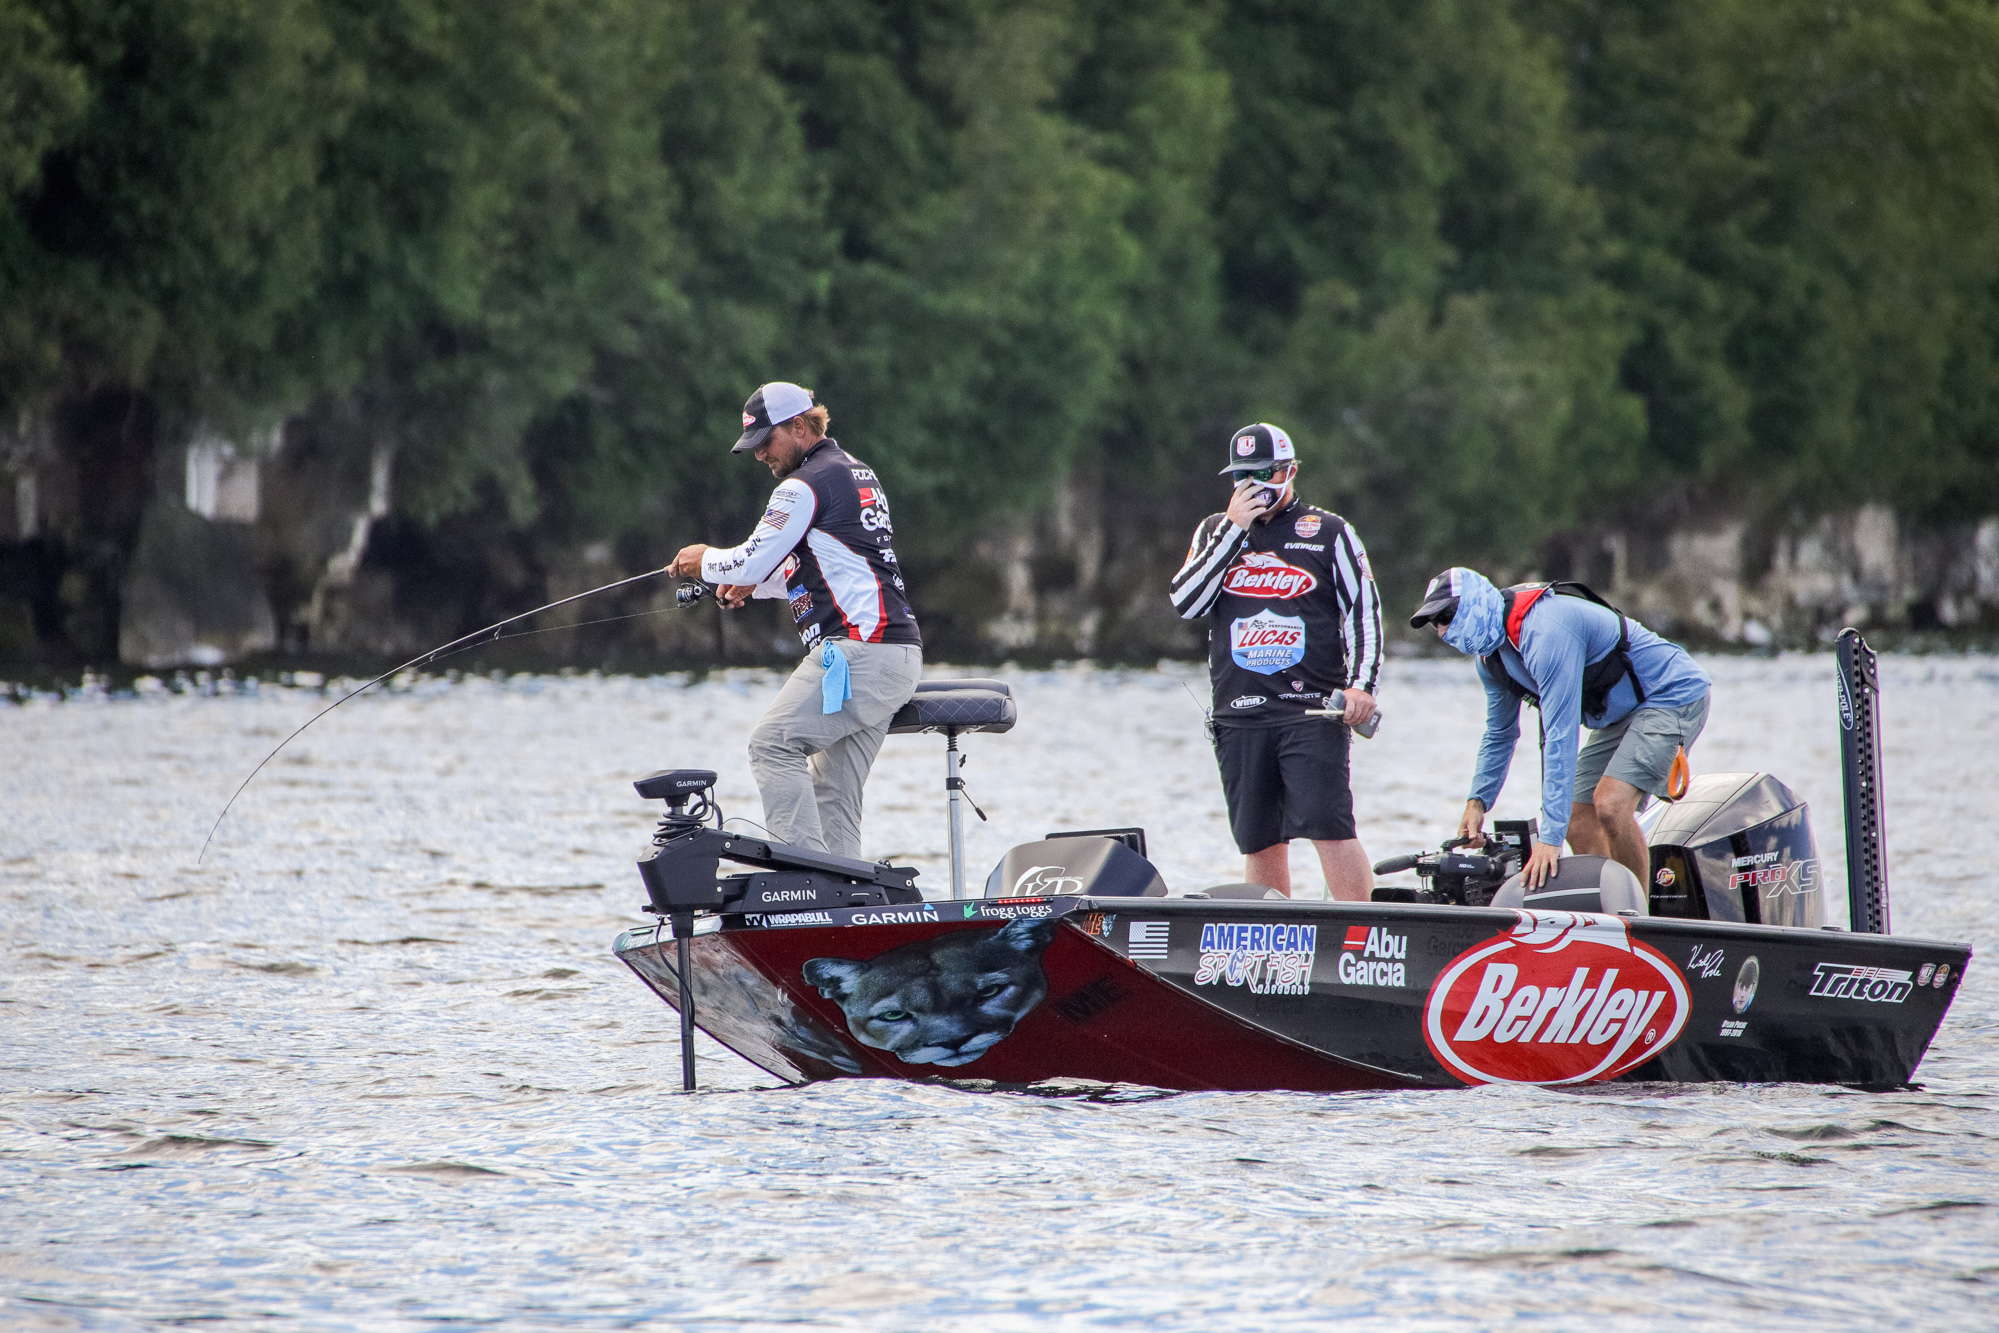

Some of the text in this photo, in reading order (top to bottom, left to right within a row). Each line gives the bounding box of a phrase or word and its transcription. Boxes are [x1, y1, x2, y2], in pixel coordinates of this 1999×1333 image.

[1284, 542, 1325, 552] EVINRUDE
[1229, 569, 1307, 598] Berkley
[1238, 630, 1301, 648] LUCAS
[1247, 649, 1293, 660] MARINE
[1245, 659, 1292, 668] PRODUCTS
[676, 780, 707, 788] GARMIN
[1731, 851, 1779, 868] MERCURY
[1728, 858, 1820, 898] PRO XS
[761, 889, 817, 902] GARMIN
[768, 912, 833, 925] WRAPABULL
[851, 910, 940, 926] GARMIN
[980, 904, 1053, 919] frogg toggs
[1200, 923, 1317, 954] AMERICAN
[1364, 926, 1408, 959] Abu
[1194, 953, 1314, 993] SPORT FISH
[1338, 952, 1406, 987] Garcia
[1809, 962, 1913, 1003] Triton
[1453, 963, 1667, 1062] Berkley
